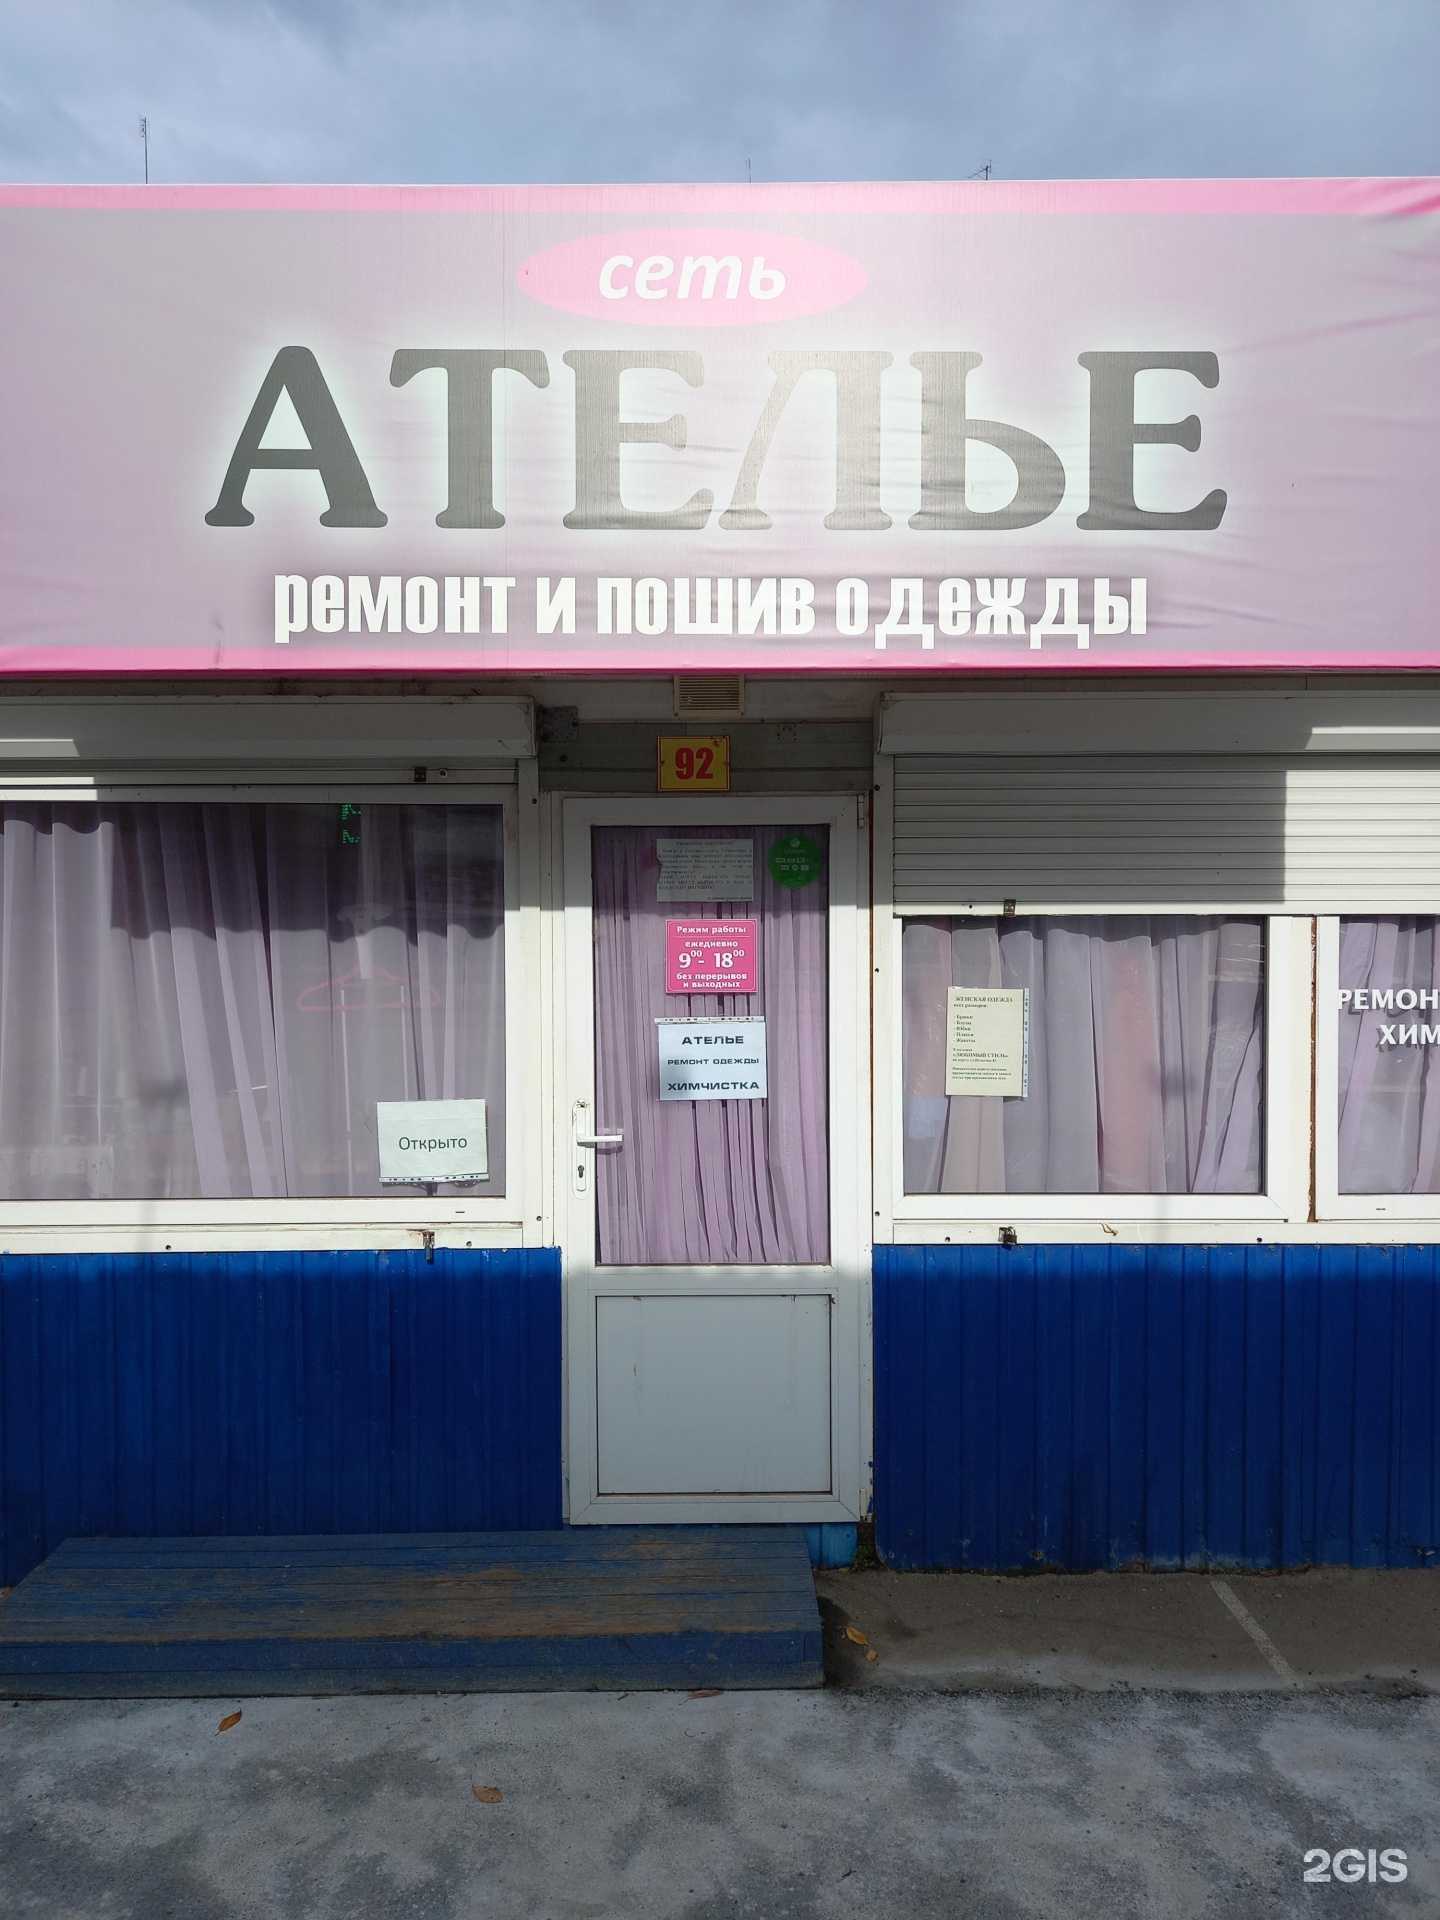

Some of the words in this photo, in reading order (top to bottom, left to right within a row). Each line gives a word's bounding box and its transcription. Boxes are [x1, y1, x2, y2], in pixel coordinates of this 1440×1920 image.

[600, 255, 786, 299] сеть
[204, 345, 1227, 530] АТЕЛЬЕ
[274, 575, 515, 643] ремонт
[536, 577, 576, 634] и
[596, 577, 815, 635] пошив
[836, 577, 1146, 650] одежды
[675, 746, 714, 780] 92
[677, 926, 708, 934] Режим
[712, 925, 746, 935] работы
[685, 941, 738, 949] ежедневно
[676, 972, 692, 980] без
[692, 981, 740, 989] выходных
[1337, 988, 1439, 1010] РЕМОН
[682, 1035, 744, 1045] АТЕЛЬЕ
[1379, 1024, 1440, 1045] ХИМ
[668, 1081, 759, 1090] ХИМЧИСТКА
[399, 1137, 467, 1152] Открыто
